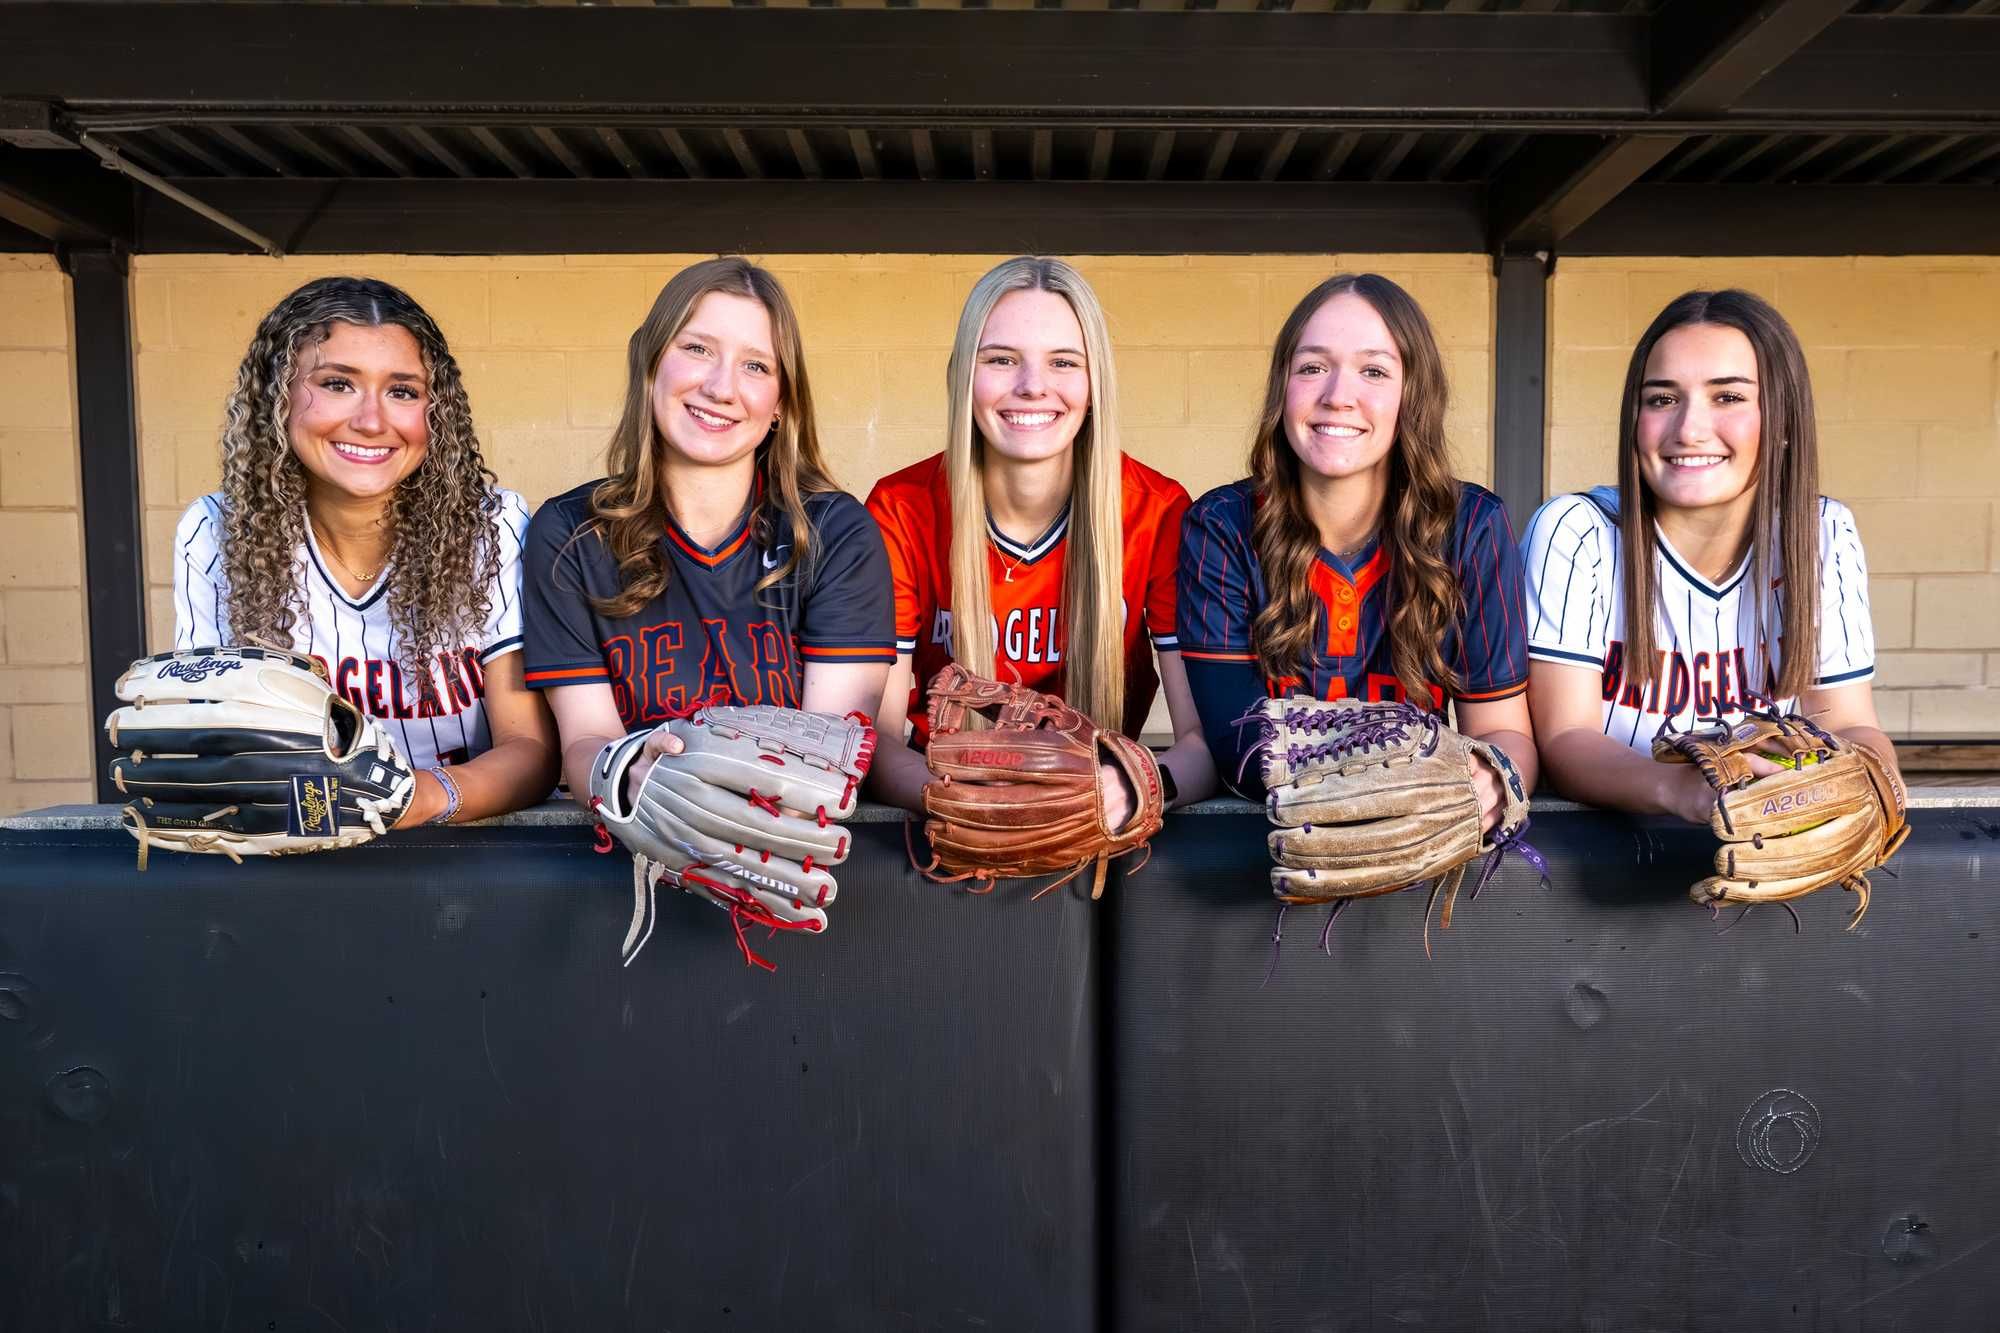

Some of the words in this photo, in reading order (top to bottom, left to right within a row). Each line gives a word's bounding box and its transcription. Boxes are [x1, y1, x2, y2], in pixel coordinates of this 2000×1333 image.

[157, 656, 243, 683] Rawlings
[603, 618, 804, 726] BEAR
[301, 780, 327, 832] Rawlings
